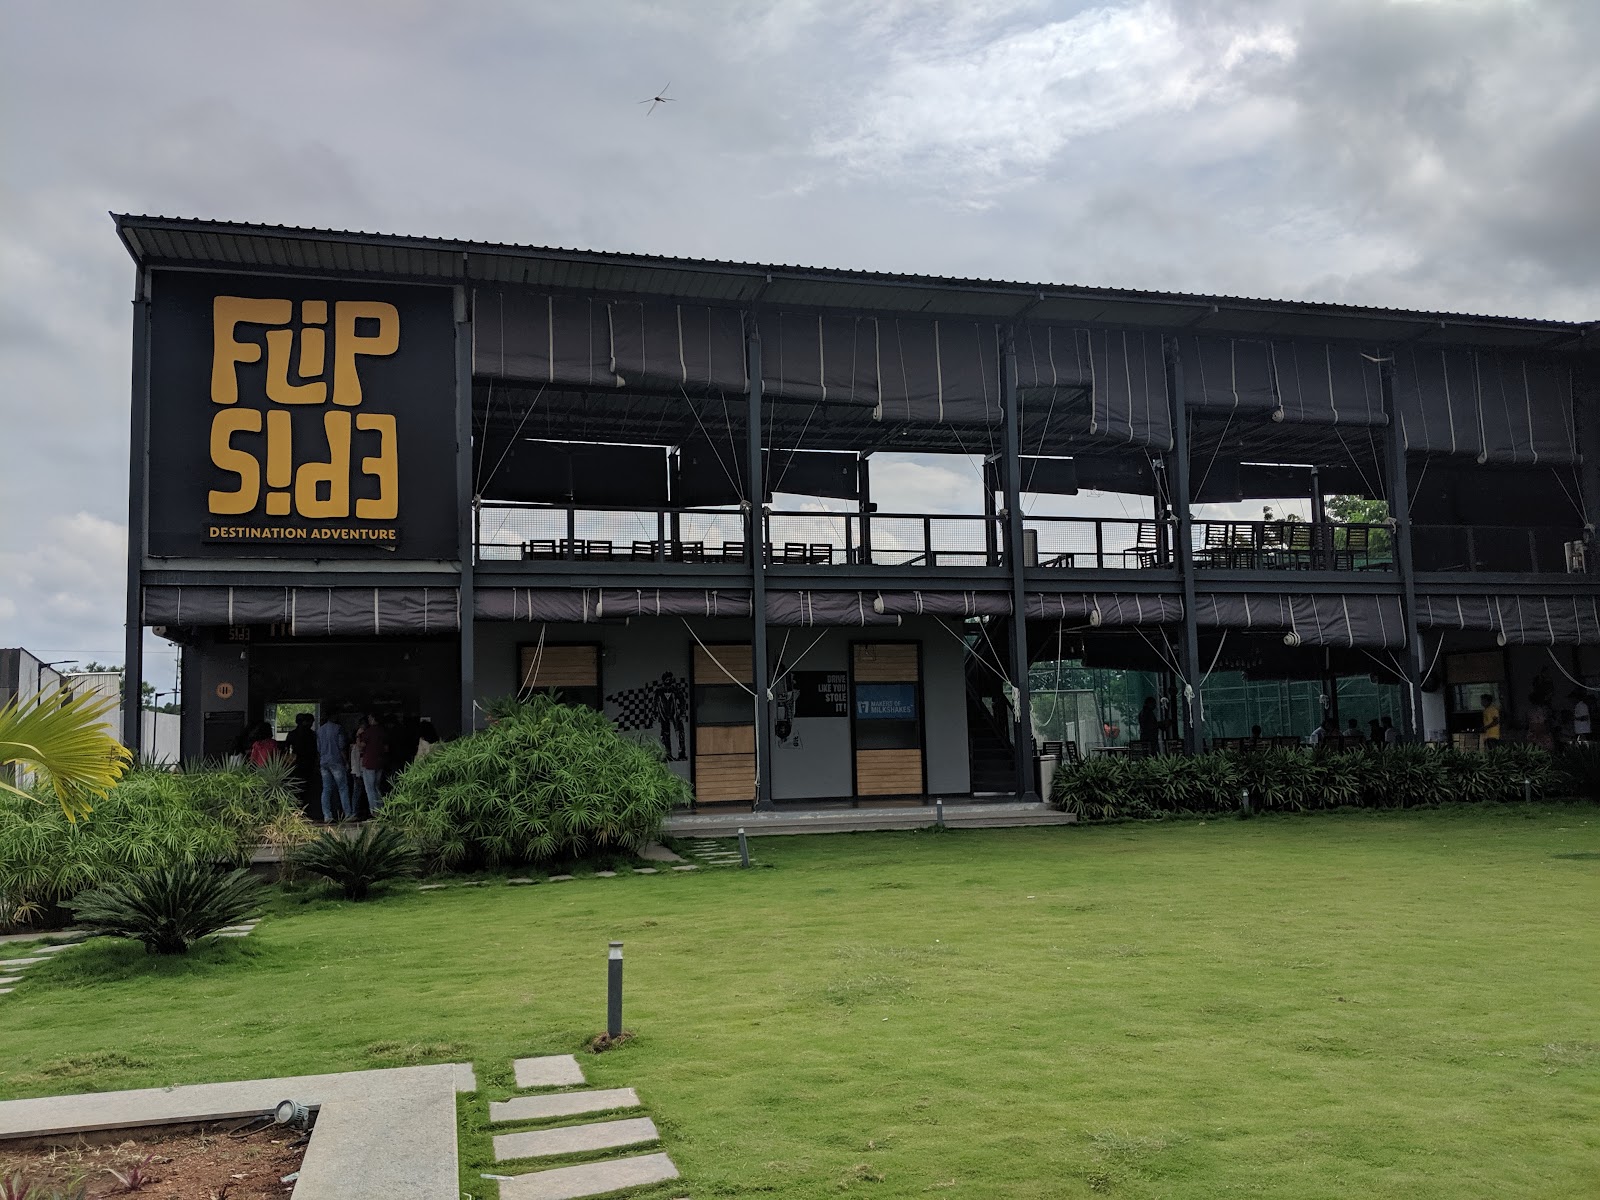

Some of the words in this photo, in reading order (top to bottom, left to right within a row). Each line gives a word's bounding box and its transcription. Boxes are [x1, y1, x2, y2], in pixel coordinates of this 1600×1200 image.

[209, 527, 307, 539] DESTINATION
[310, 528, 396, 540] ADVENTURE
[827, 675, 846, 683] DRIVE
[818, 684, 832, 692] LIKE
[833, 684, 846, 692] YOU
[825, 693, 847, 702] STOLE
